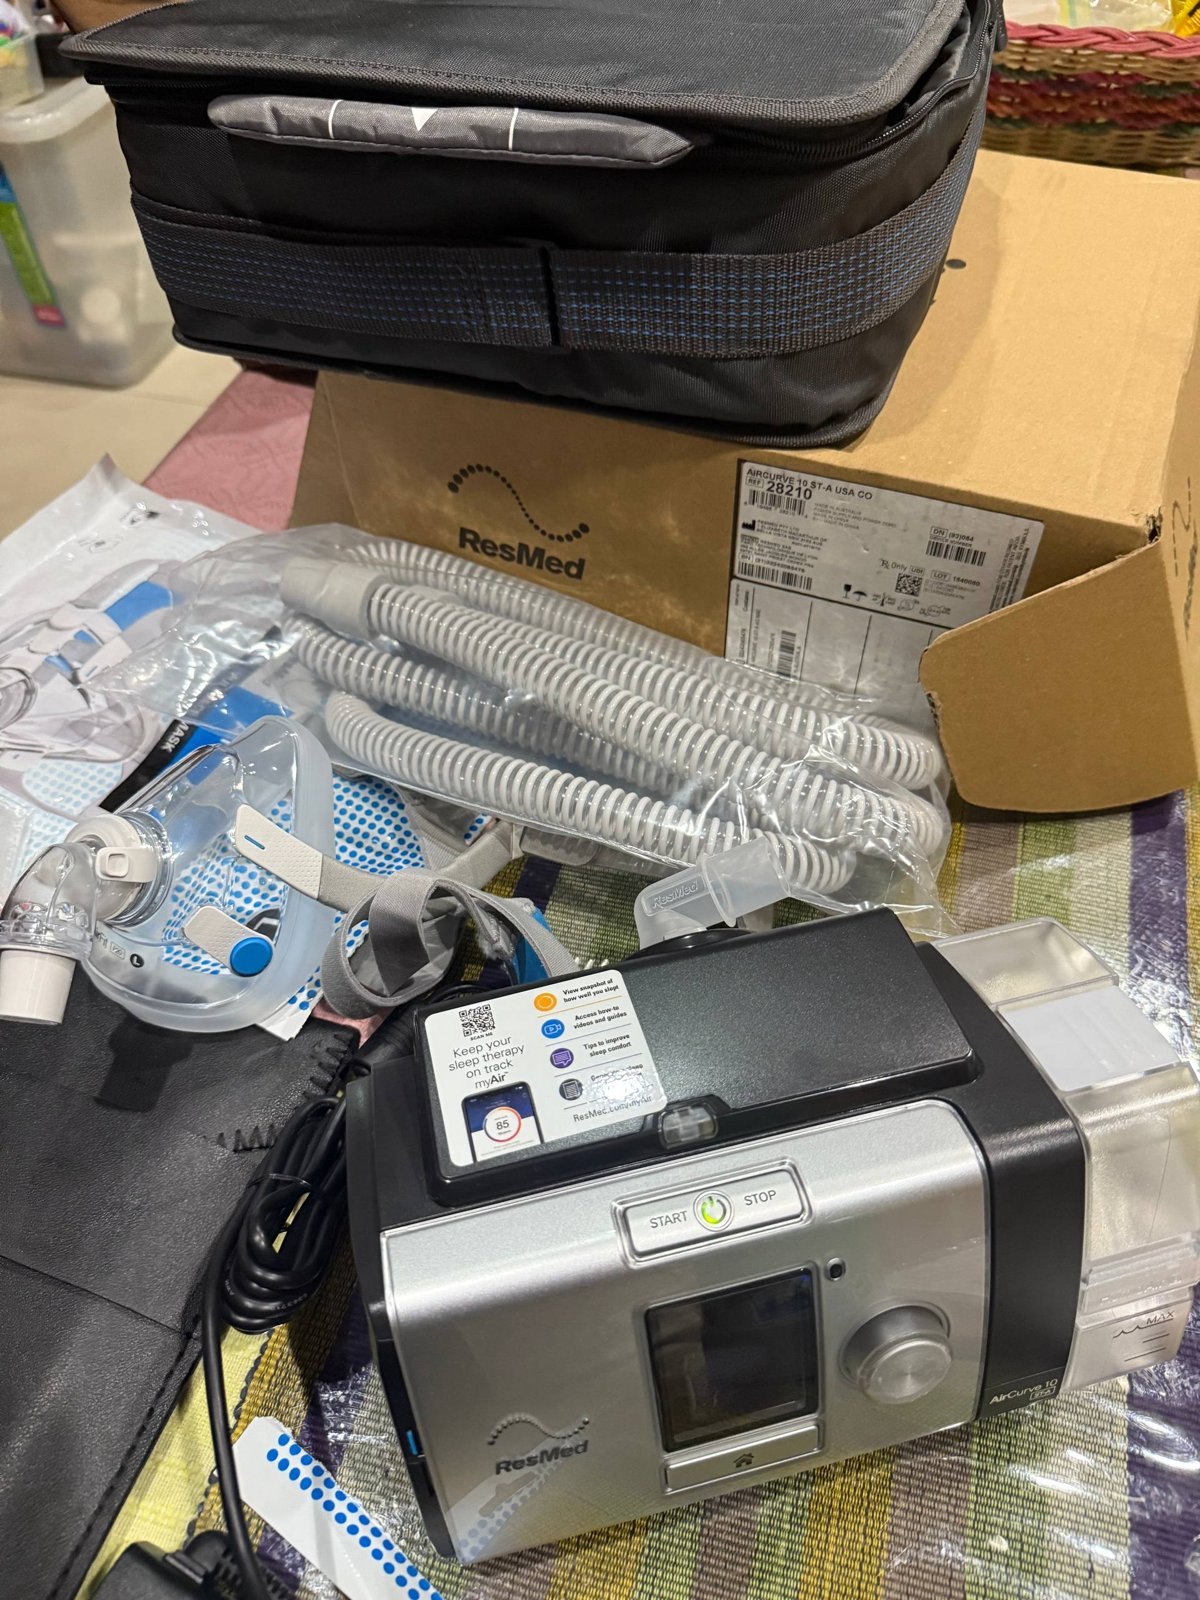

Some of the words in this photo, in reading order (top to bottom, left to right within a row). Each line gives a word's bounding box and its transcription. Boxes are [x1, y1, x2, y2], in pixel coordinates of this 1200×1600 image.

[747, 468, 795, 486] AIRCURVE
[798, 478, 808, 488] 10
[810, 480, 833, 493] ST-A
[835, 486, 855, 497] USA
[857, 490, 873, 501] CO
[766, 481, 813, 501] 28210
[459, 526, 586, 580] ResMed
[891, 561, 908, 573] Only
[653, 880, 699, 909] ResMed
[563, 988, 579, 996] View
[580, 980, 606, 992] snapshot
[563, 995, 577, 1003] how
[593, 989, 604, 997] you
[604, 985, 619, 995] slept
[573, 1020, 594, 1030] videos
[595, 1017, 606, 1025] and
[607, 1011, 628, 1022] guides
[575, 1011, 597, 1021] Access
[598, 1005, 620, 1015] how-to
[470, 1033, 485, 1041] SCAN
[583, 1042, 597, 1050] Tips
[605, 1034, 630, 1045] improve
[453, 1044, 484, 1058] Keep
[486, 1036, 512, 1051] your
[590, 1047, 607, 1057] sleep
[608, 1041, 632, 1052] comfort
[448, 1057, 480, 1072] sleep
[482, 1044, 525, 1063] therapy
[466, 1068, 482, 1079] on
[484, 1058, 514, 1074] track
[496, 1119, 510, 1130] 85
[744, 1189, 777, 1206] STOP
[650, 1210, 688, 1229] START
[1146, 1310, 1175, 1325] MAX
[989, 1382, 1042, 1405] AirCurve
[1044, 1378, 1058, 1389] 10
[495, 1439, 590, 1475] ResMed
